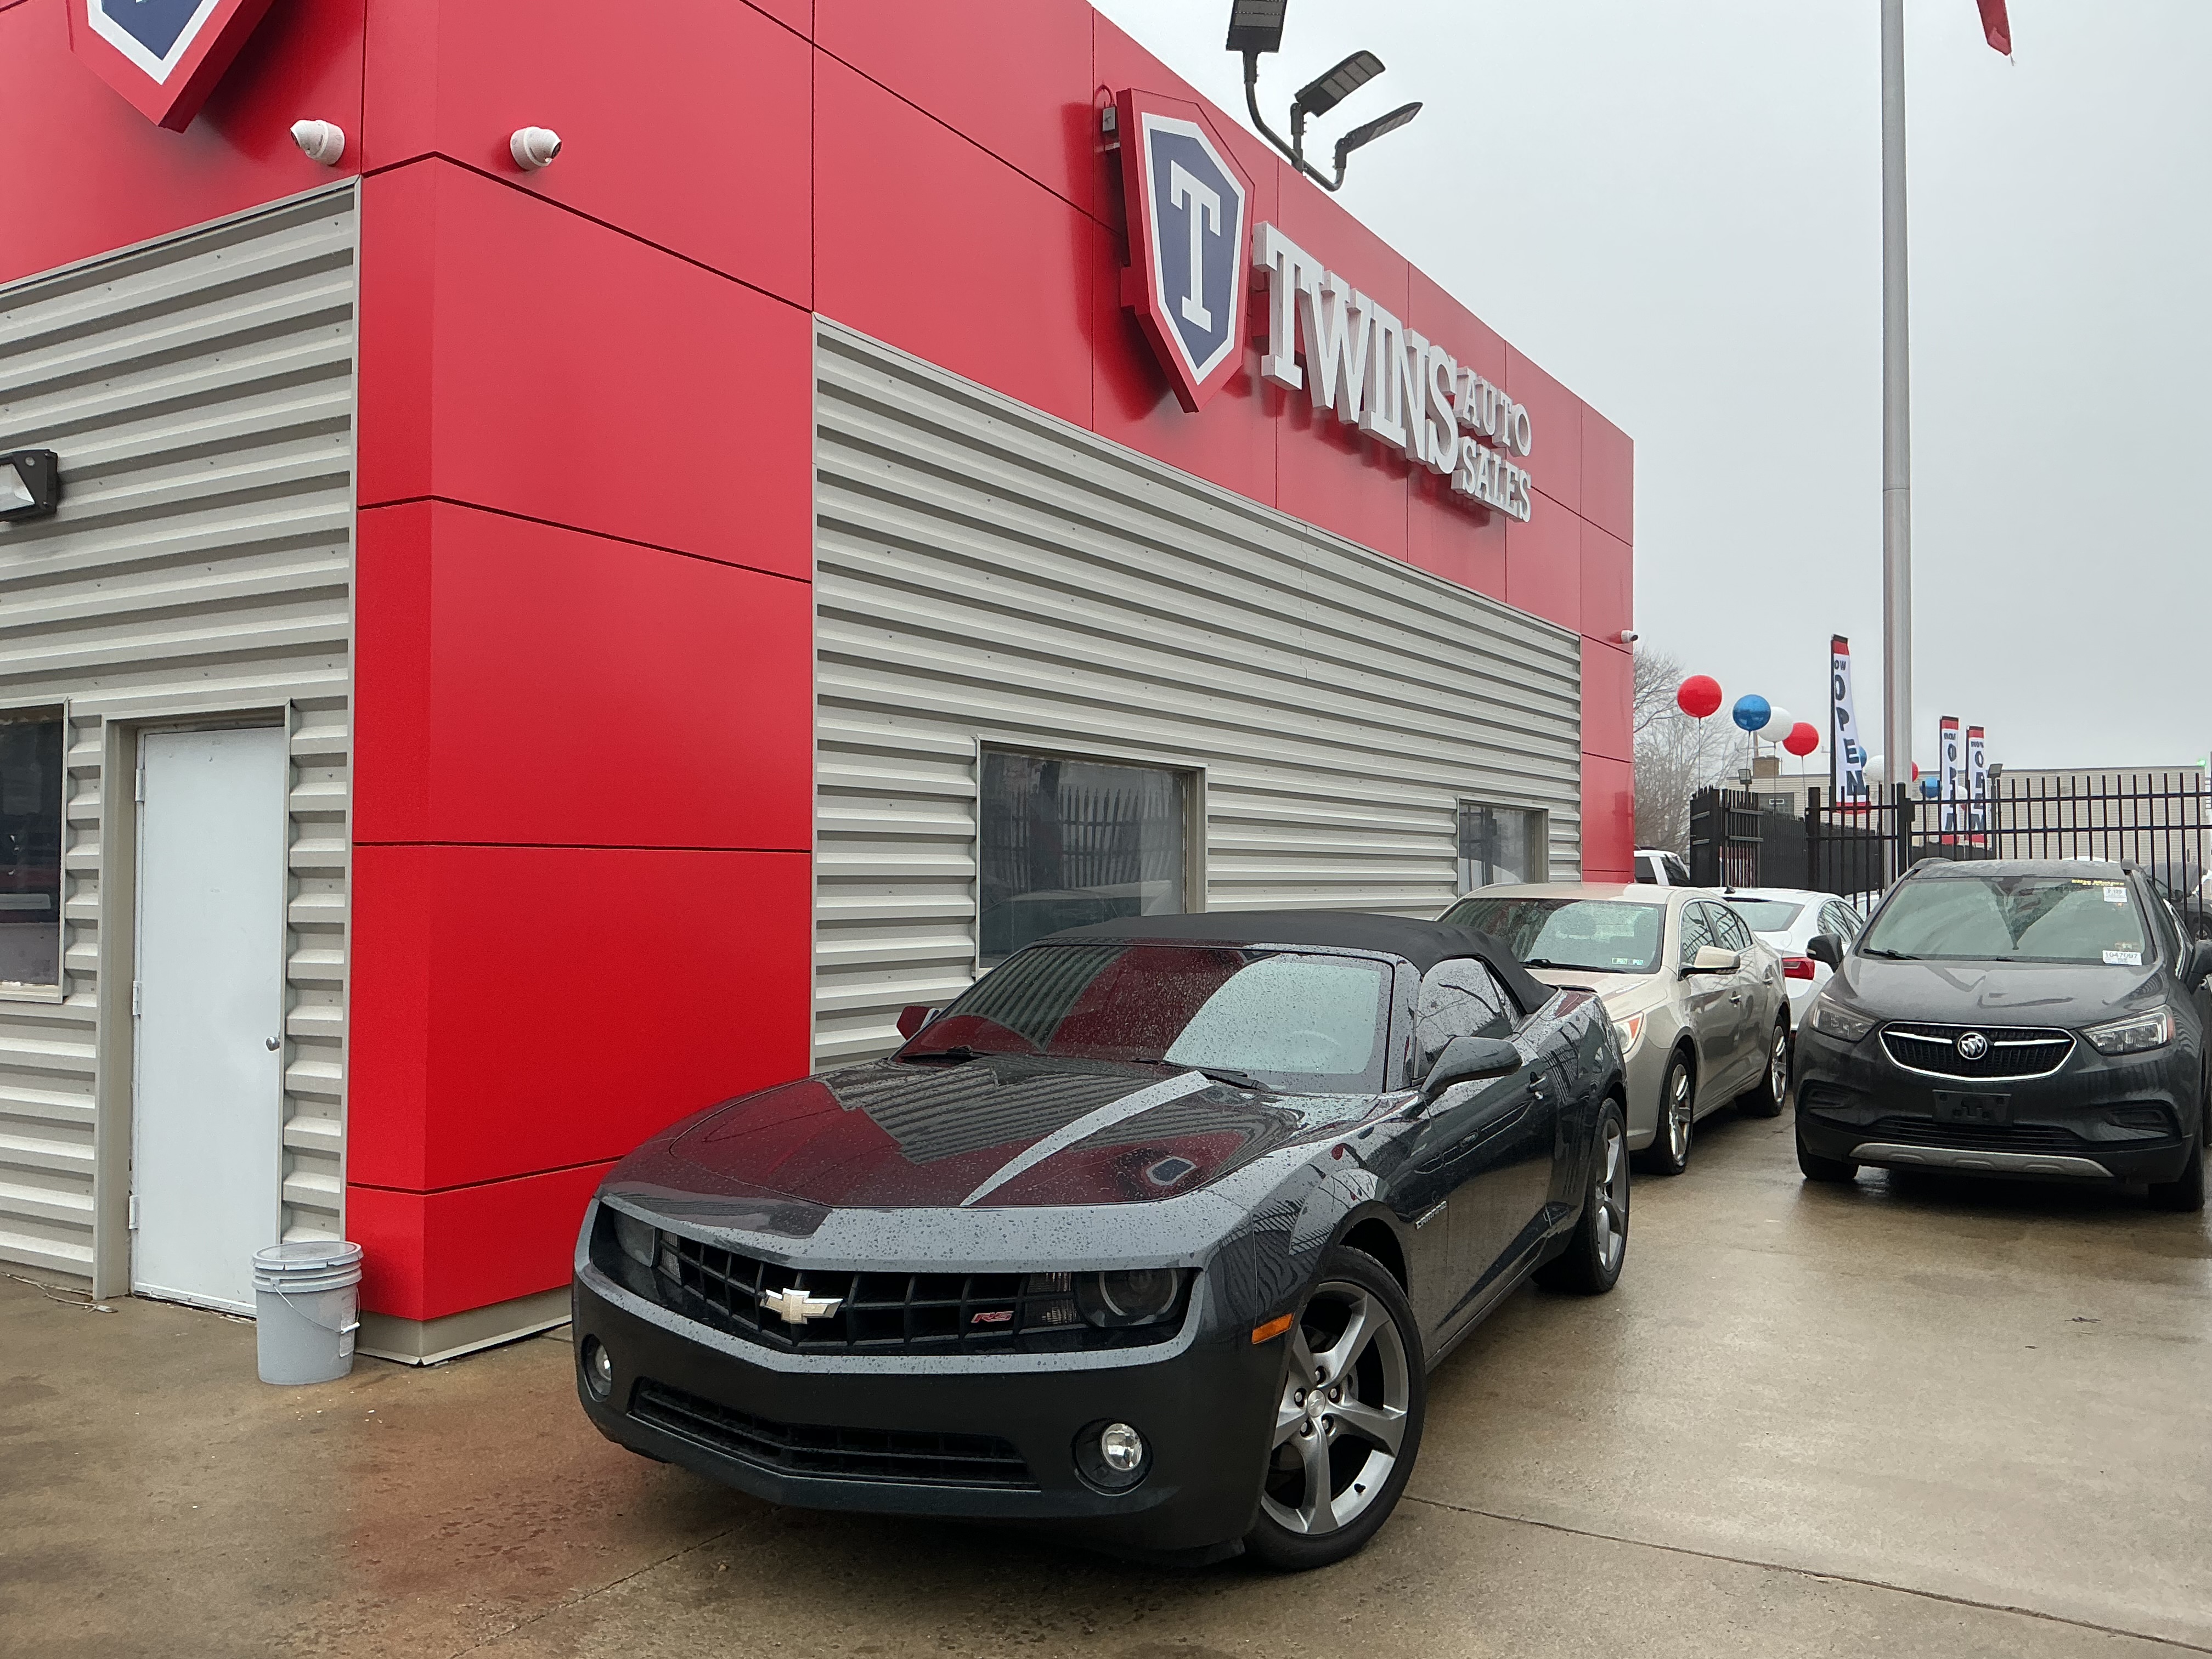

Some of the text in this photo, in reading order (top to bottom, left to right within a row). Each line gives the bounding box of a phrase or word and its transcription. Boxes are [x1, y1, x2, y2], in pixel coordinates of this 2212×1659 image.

[1170, 159, 1221, 333] T
[1253, 221, 1459, 475] TWINS
[1454, 366, 1532, 458] AUTO
[1451, 436, 1532, 523] SALES
[1834, 659, 1846, 671] OW
[1835, 674, 1866, 795] OPEN
[970, 1311, 1014, 1323] RS
